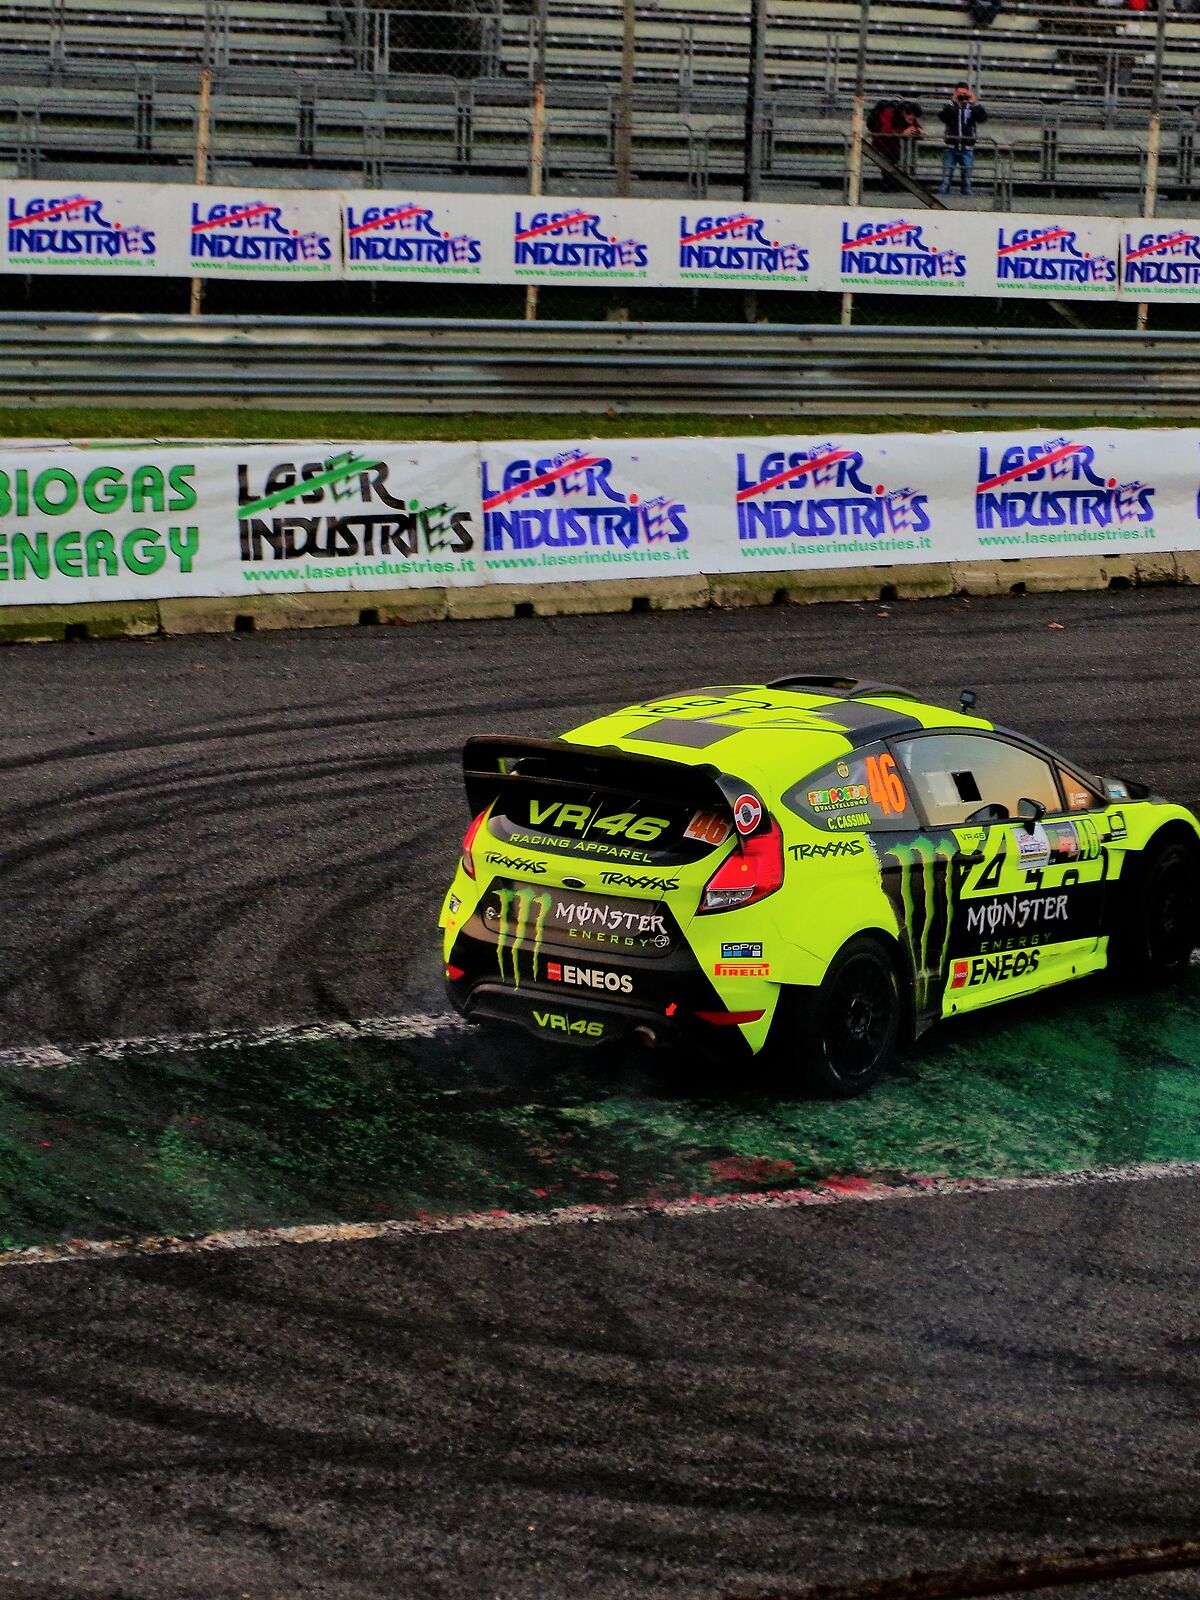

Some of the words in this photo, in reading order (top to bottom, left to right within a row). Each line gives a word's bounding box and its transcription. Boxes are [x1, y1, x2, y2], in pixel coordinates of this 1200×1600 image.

[7, 194, 112, 230] LASER
[190, 200, 289, 235] LASER
[347, 202, 442, 238] LASER
[513, 208, 608, 242] LASER
[7, 227, 157, 257] INDUSTRIES
[679, 213, 771, 246] LASER
[841, 219, 929, 252] LASER
[996, 226, 1080, 258] LASER
[190, 232, 332, 262] INDUSTRIES
[347, 235, 482, 265] INDUSTRIES
[513, 240, 649, 269] INDUSTRIES
[679, 244, 810, 272] INDUSTRIES
[841, 250, 967, 278] INDUSTRIES
[996, 256, 1116, 283] INDUSTRIES
[482, 447, 626, 503] LASER
[737, 442, 876, 494] LASER
[977, 436, 1106, 487] LASER
[238, 451, 404, 511] LASER
[738, 486, 932, 539] INDUSTRIES
[976, 480, 1156, 529] INDUSTRIES
[238, 501, 474, 561] INDUSTRIES
[483, 497, 689, 551] INDUSTRIES
[979, 528, 1156, 546] www.laserindustries.it
[485, 548, 689, 570] www.laserindustries.it
[741, 537, 933, 557] www.laserindustries.it
[243, 559, 476, 581] www.laserindustries.it
[865, 752, 906, 815] 46
[689, 810, 728, 844] 46
[837, 812, 872, 829] CASSINA
[484, 851, 548, 874] TRAXXAS
[510, 832, 571, 849] RACING
[574, 841, 652, 863] APPAREL
[788, 840, 865, 860] TRAXXAS
[600, 872, 680, 891] TRAXXAS
[569, 928, 649, 947] ENERGY
[981, 932, 1051, 953] ENERGY
[563, 965, 634, 993] ENEOS
[714, 964, 770, 976] PIRELLI
[968, 949, 1040, 986] ENEOS
